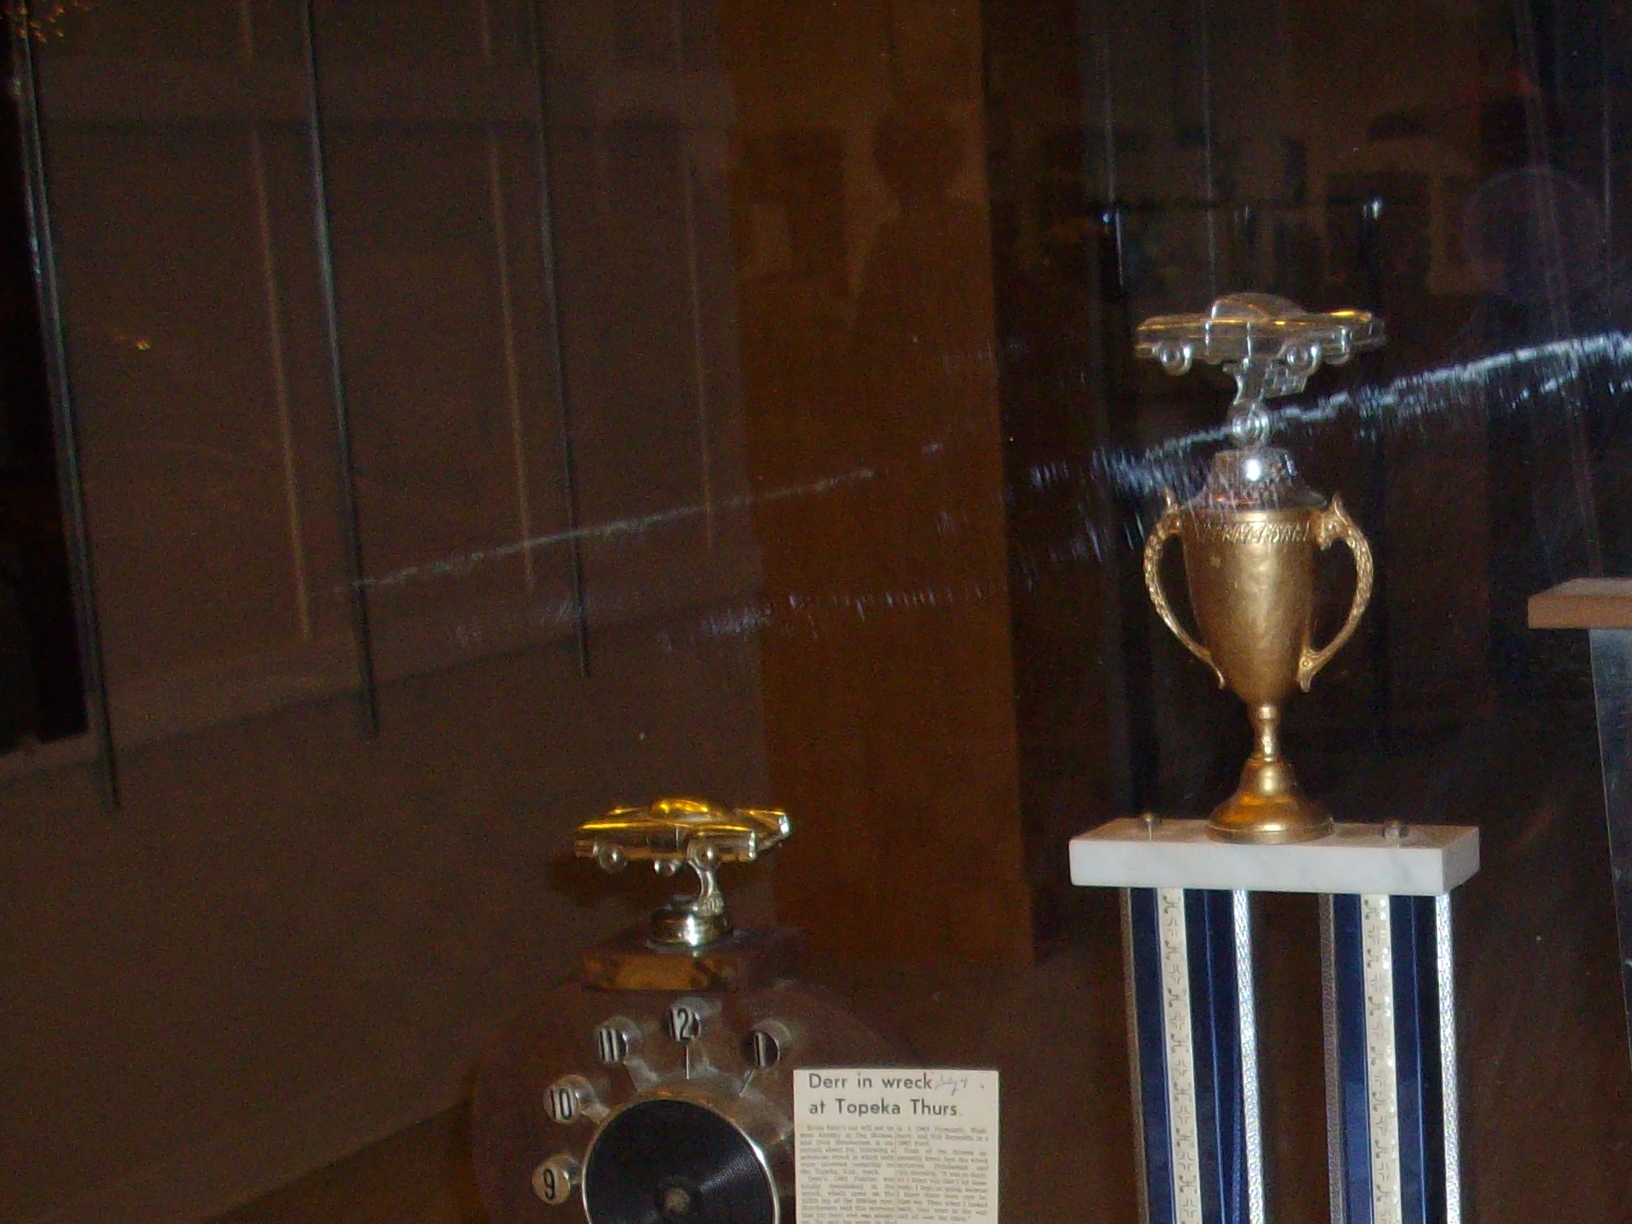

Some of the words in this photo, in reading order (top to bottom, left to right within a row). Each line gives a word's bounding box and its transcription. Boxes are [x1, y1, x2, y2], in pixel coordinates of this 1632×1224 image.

[670, 1008, 691, 1041] 12
[808, 1073, 847, 1089] Derr
[857, 1073, 873, 1088] in
[882, 1073, 933, 1089] wreck
[550, 1087, 573, 1121] 10
[808, 1100, 826, 1115] at
[836, 1098, 901, 1117] Topeka
[542, 1168, 556, 1200] 9
